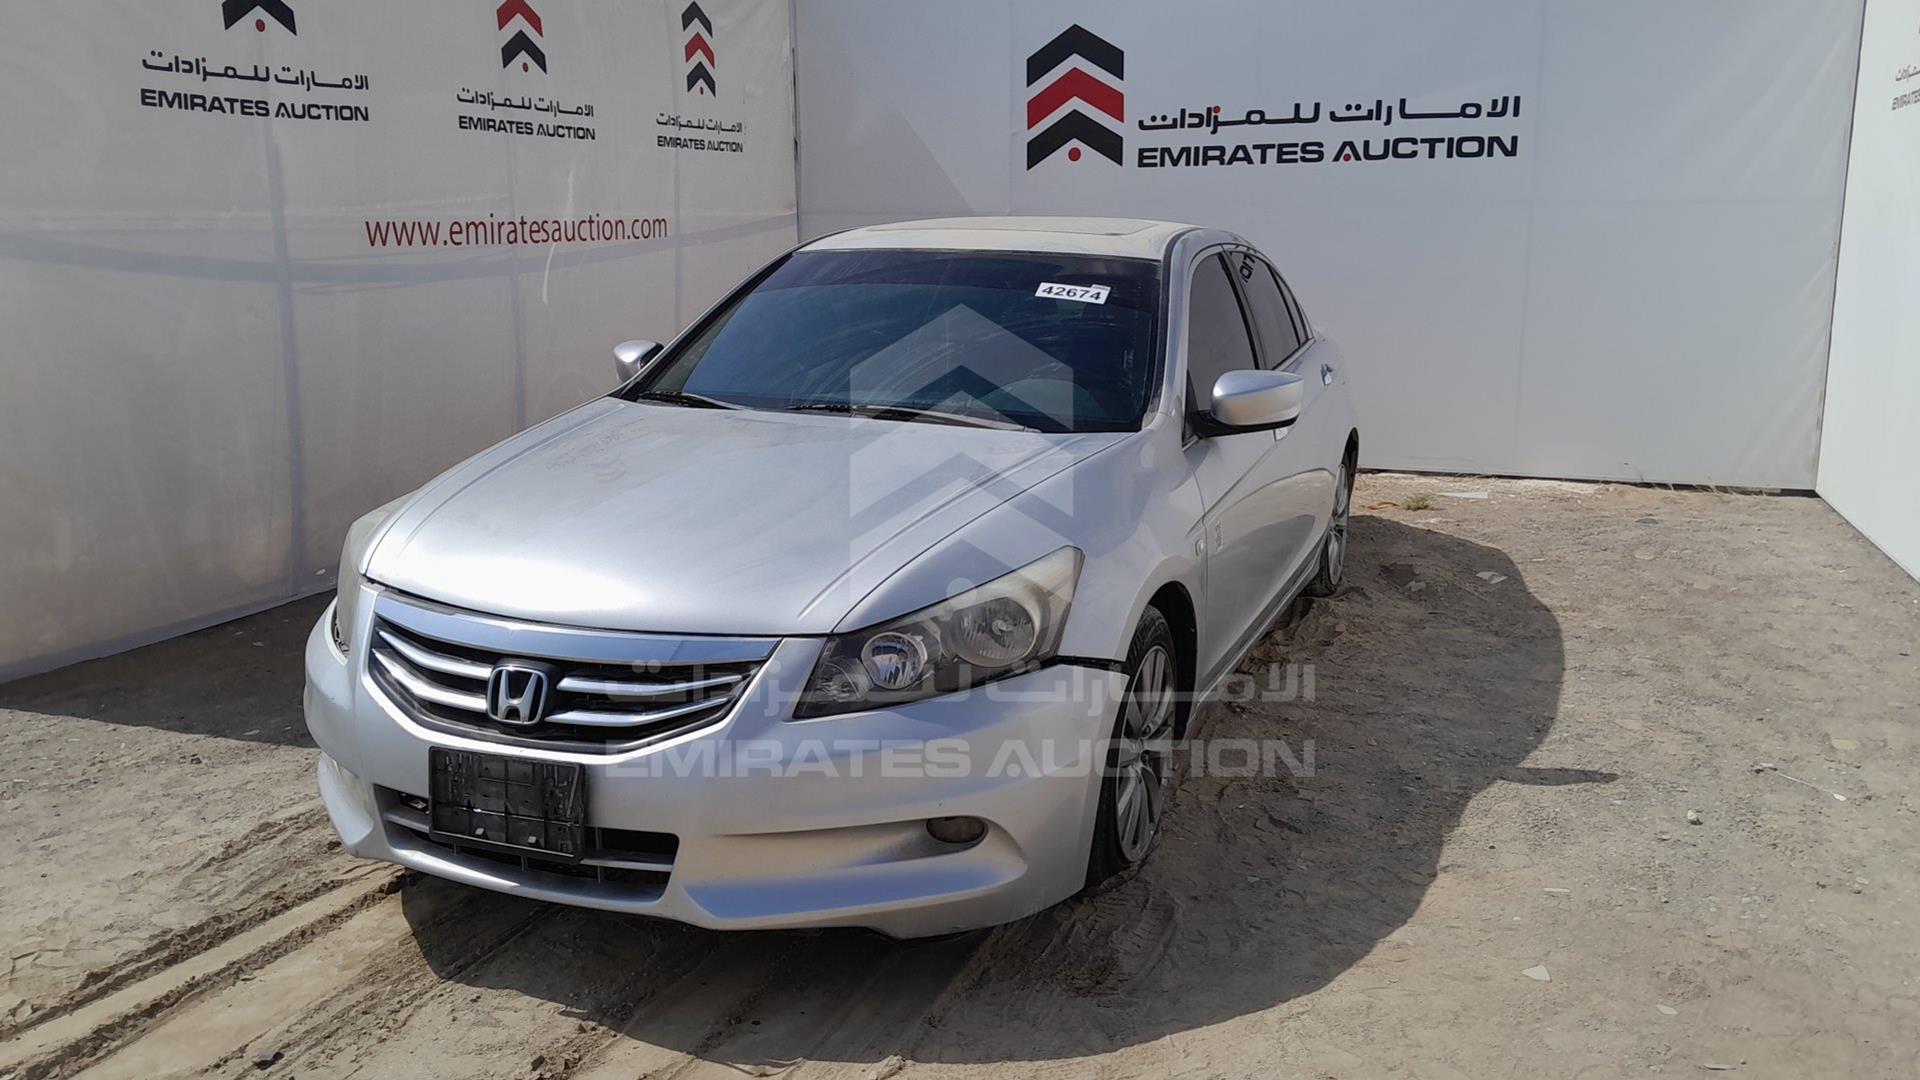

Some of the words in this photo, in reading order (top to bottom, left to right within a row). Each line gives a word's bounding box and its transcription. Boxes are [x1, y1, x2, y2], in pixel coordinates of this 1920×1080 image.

[141, 88, 269, 117] EMIRATES
[275, 103, 368, 121] AUCTION
[1138, 102, 1320, 134] للمزادات
[1330, 96, 1520, 126] الامارات
[459, 116, 533, 135] EMIRATES
[537, 124, 595, 140] AUCTION
[658, 136, 705, 150] EMIRATES
[707, 141, 742, 152] AUCTION
[1138, 142, 1324, 167] EMIRATES
[1333, 136, 1518, 162] AUCTION
[365, 213, 667, 246] www.emiratesauction.com
[1042, 286, 1101, 300] 42674
